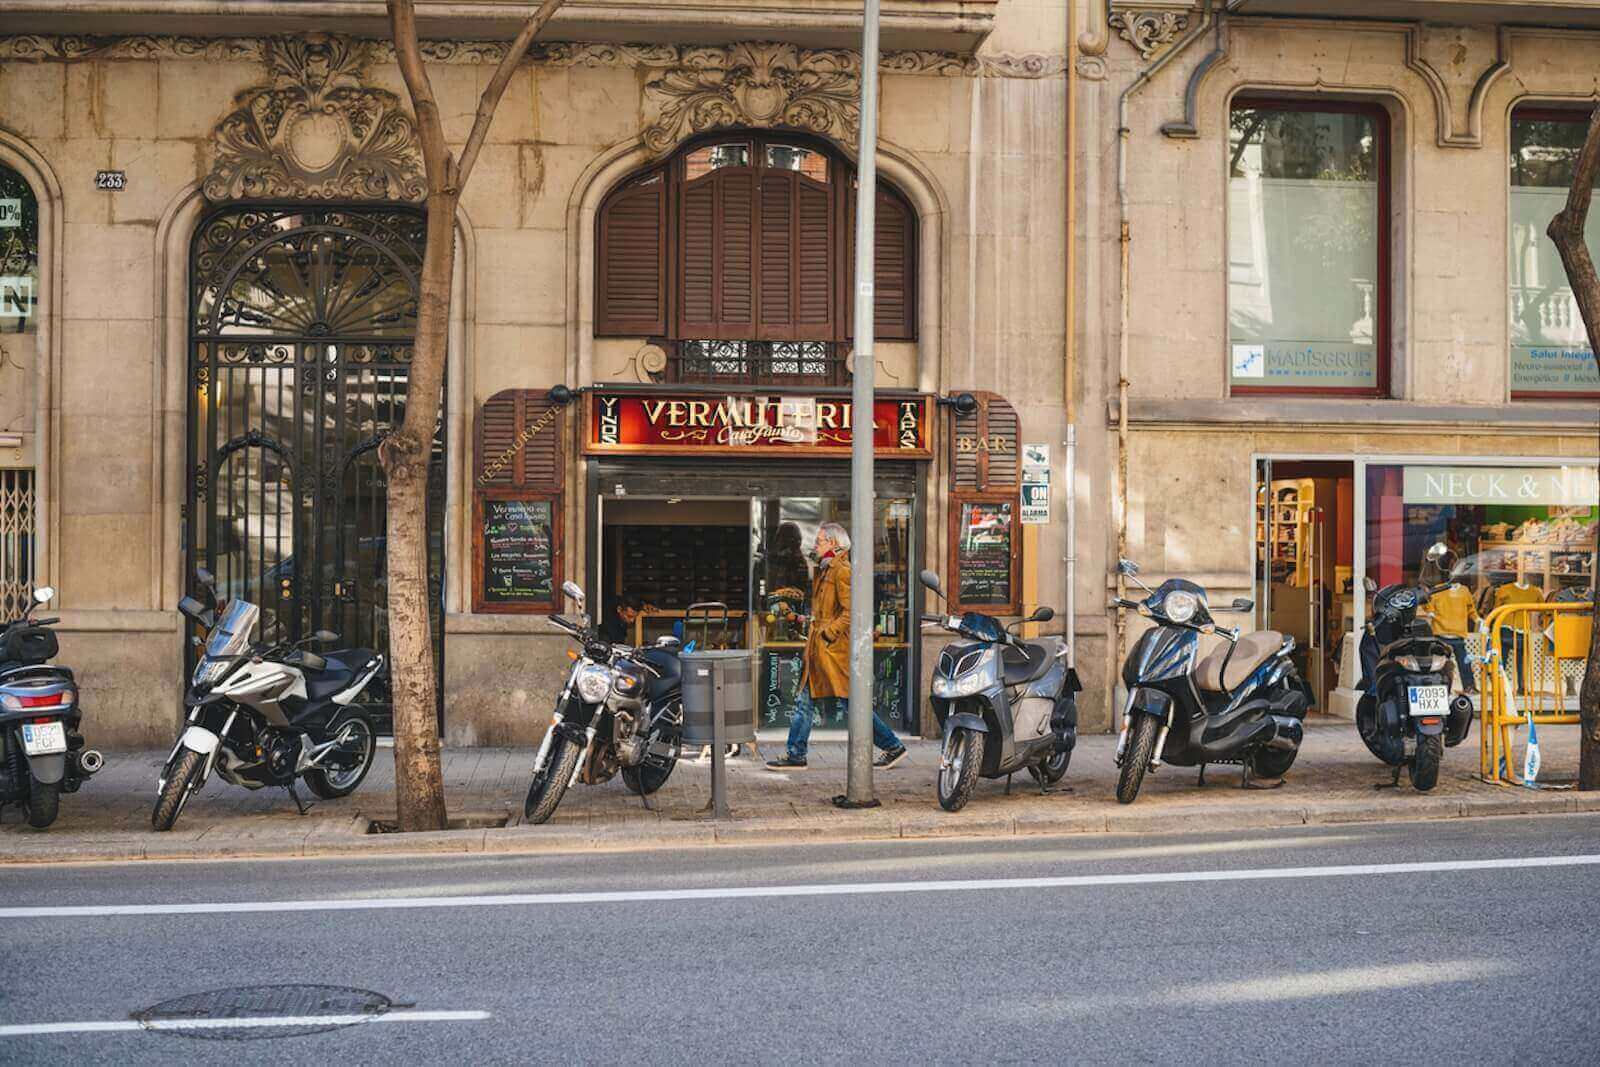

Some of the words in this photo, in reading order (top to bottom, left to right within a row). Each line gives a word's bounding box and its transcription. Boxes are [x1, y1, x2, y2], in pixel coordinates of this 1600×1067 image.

[98, 172, 123, 188] 233
[601, 397, 618, 446] VINOS
[643, 399, 880, 430] VERMUTERI
[901, 402, 917, 449] TAPAS
[478, 404, 562, 485] RESTAURANTE
[959, 436, 1008, 452] BAR
[1424, 473, 1511, 498] NECK
[1517, 473, 1541, 499] &
[1550, 474, 1592, 498] NE
[1418, 688, 1445, 698] 2093
[1419, 699, 1440, 710] HXX
